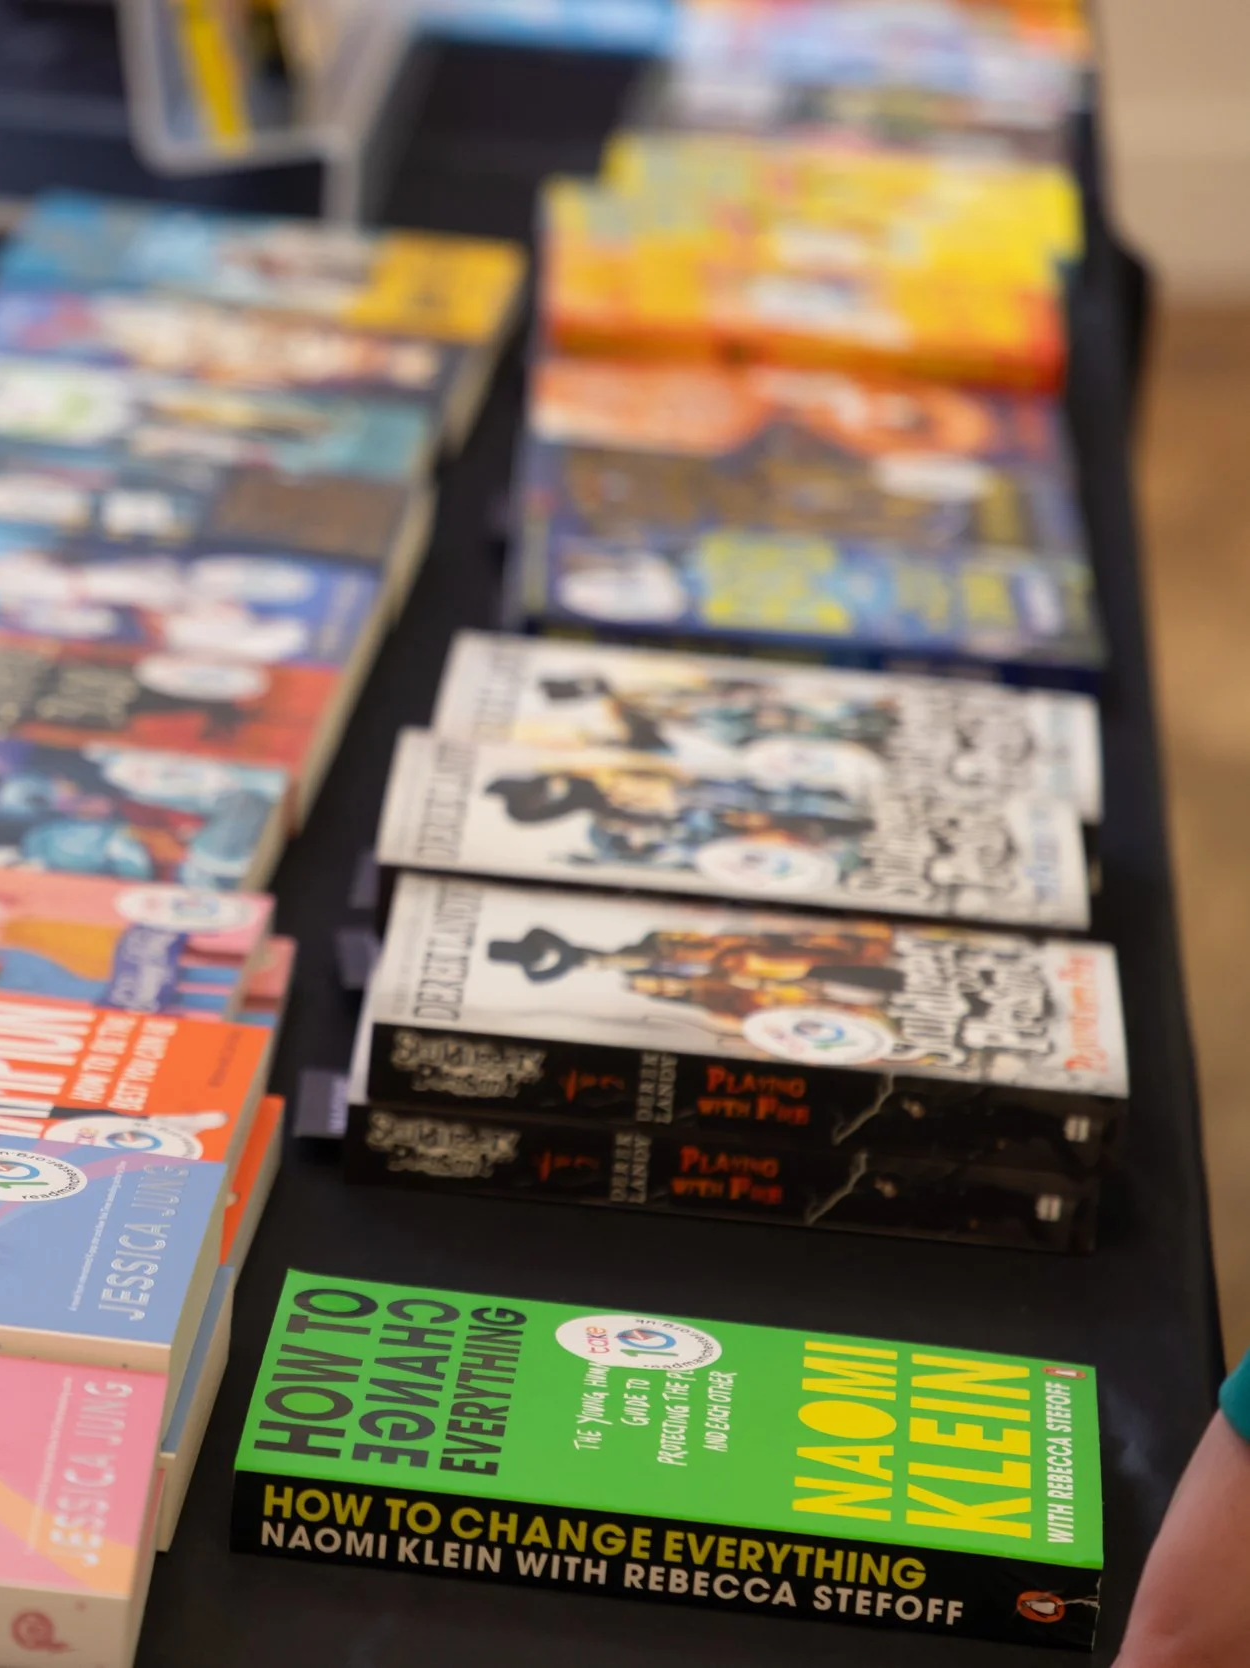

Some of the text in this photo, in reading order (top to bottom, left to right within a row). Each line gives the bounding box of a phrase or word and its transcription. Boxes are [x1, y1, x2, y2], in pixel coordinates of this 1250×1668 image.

[130, 1164, 190, 1217] JUNG
[98, 1222, 171, 1321] JESSICA
[74, 1380, 133, 1446] JUNG
[253, 1289, 378, 1459] HOW TO
[439, 1307, 527, 1476] EVERYTHING
[575, 1392, 613, 1425] YOUNG
[620, 1377, 651, 1426] GUIDE TO
[662, 1380, 690, 1401] THE
[703, 1370, 737, 1452] AND EACH OTHER
[573, 1429, 602, 1450] THE
[656, 1404, 690, 1466] PROTECTING
[792, 1340, 898, 1522] NAOMI
[905, 1353, 1031, 1540] KLEIN
[1045, 1381, 1075, 1543] WITH REBECCA STEFOFF
[49, 1453, 118, 1566] JESSICA
[264, 1484, 927, 1590] HOW TO CHANGE EVERYTHING
[261, 1520, 963, 1625] NAOMI KLEIN WITH REBECCA STEFOFF
